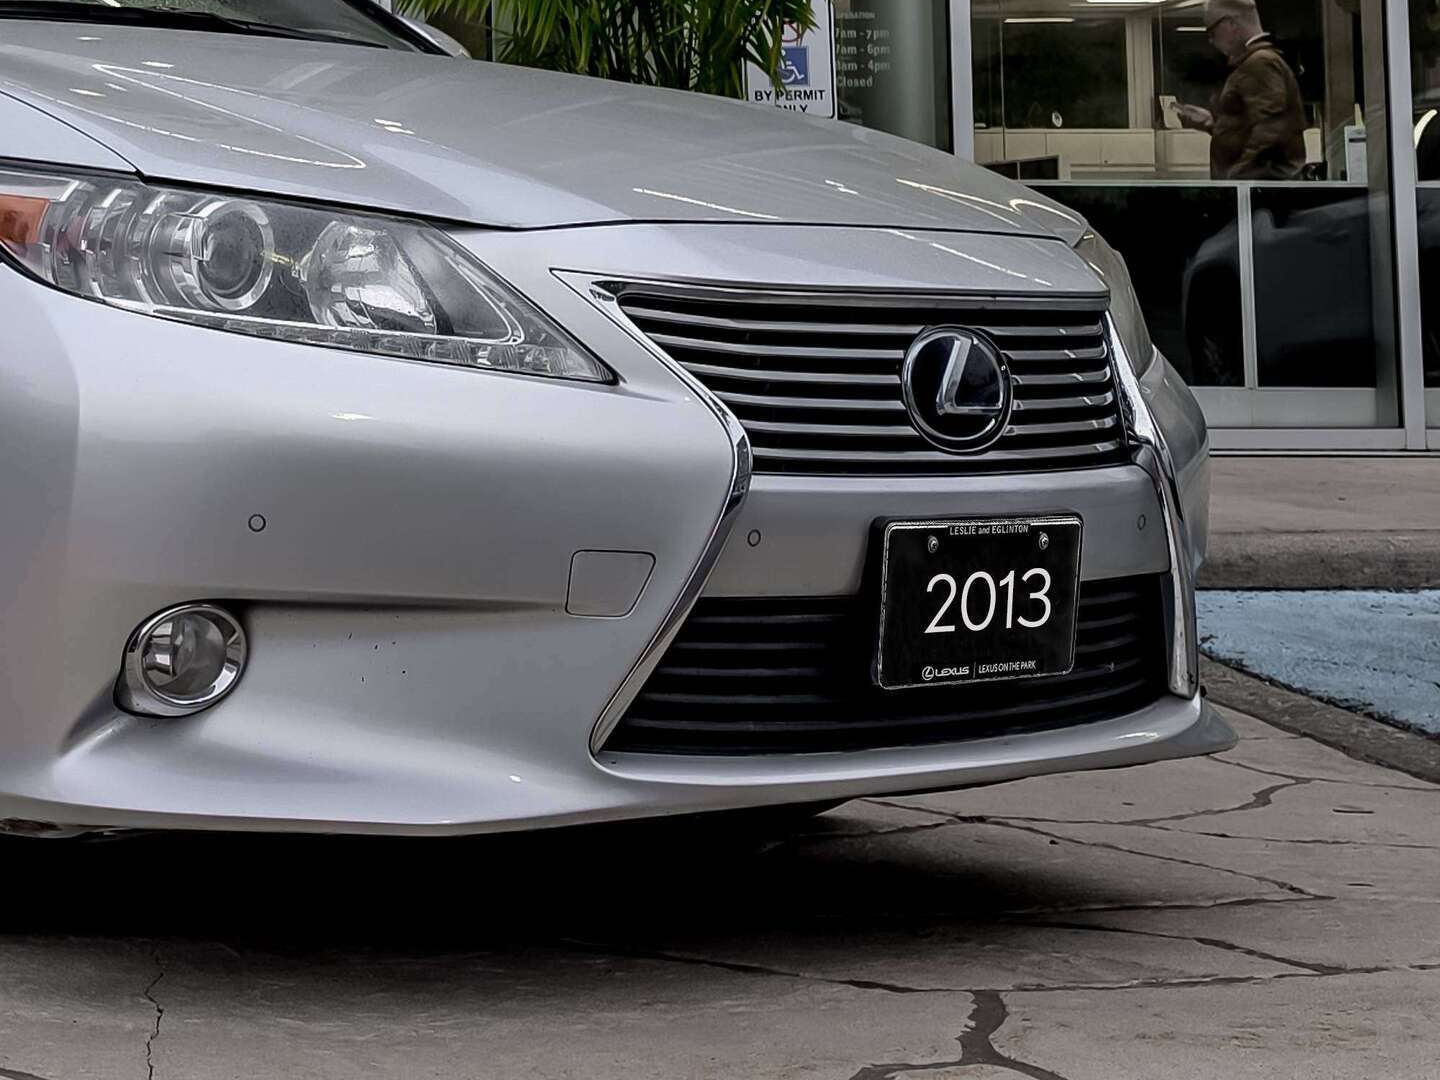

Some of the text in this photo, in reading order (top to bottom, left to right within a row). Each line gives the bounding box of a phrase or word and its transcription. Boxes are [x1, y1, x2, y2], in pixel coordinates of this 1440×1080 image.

[754, 89, 826, 102] BY PERMIT
[949, 525, 977, 536] LESLIE
[924, 567, 1052, 634] 2013
[935, 666, 970, 677] LEXUS
